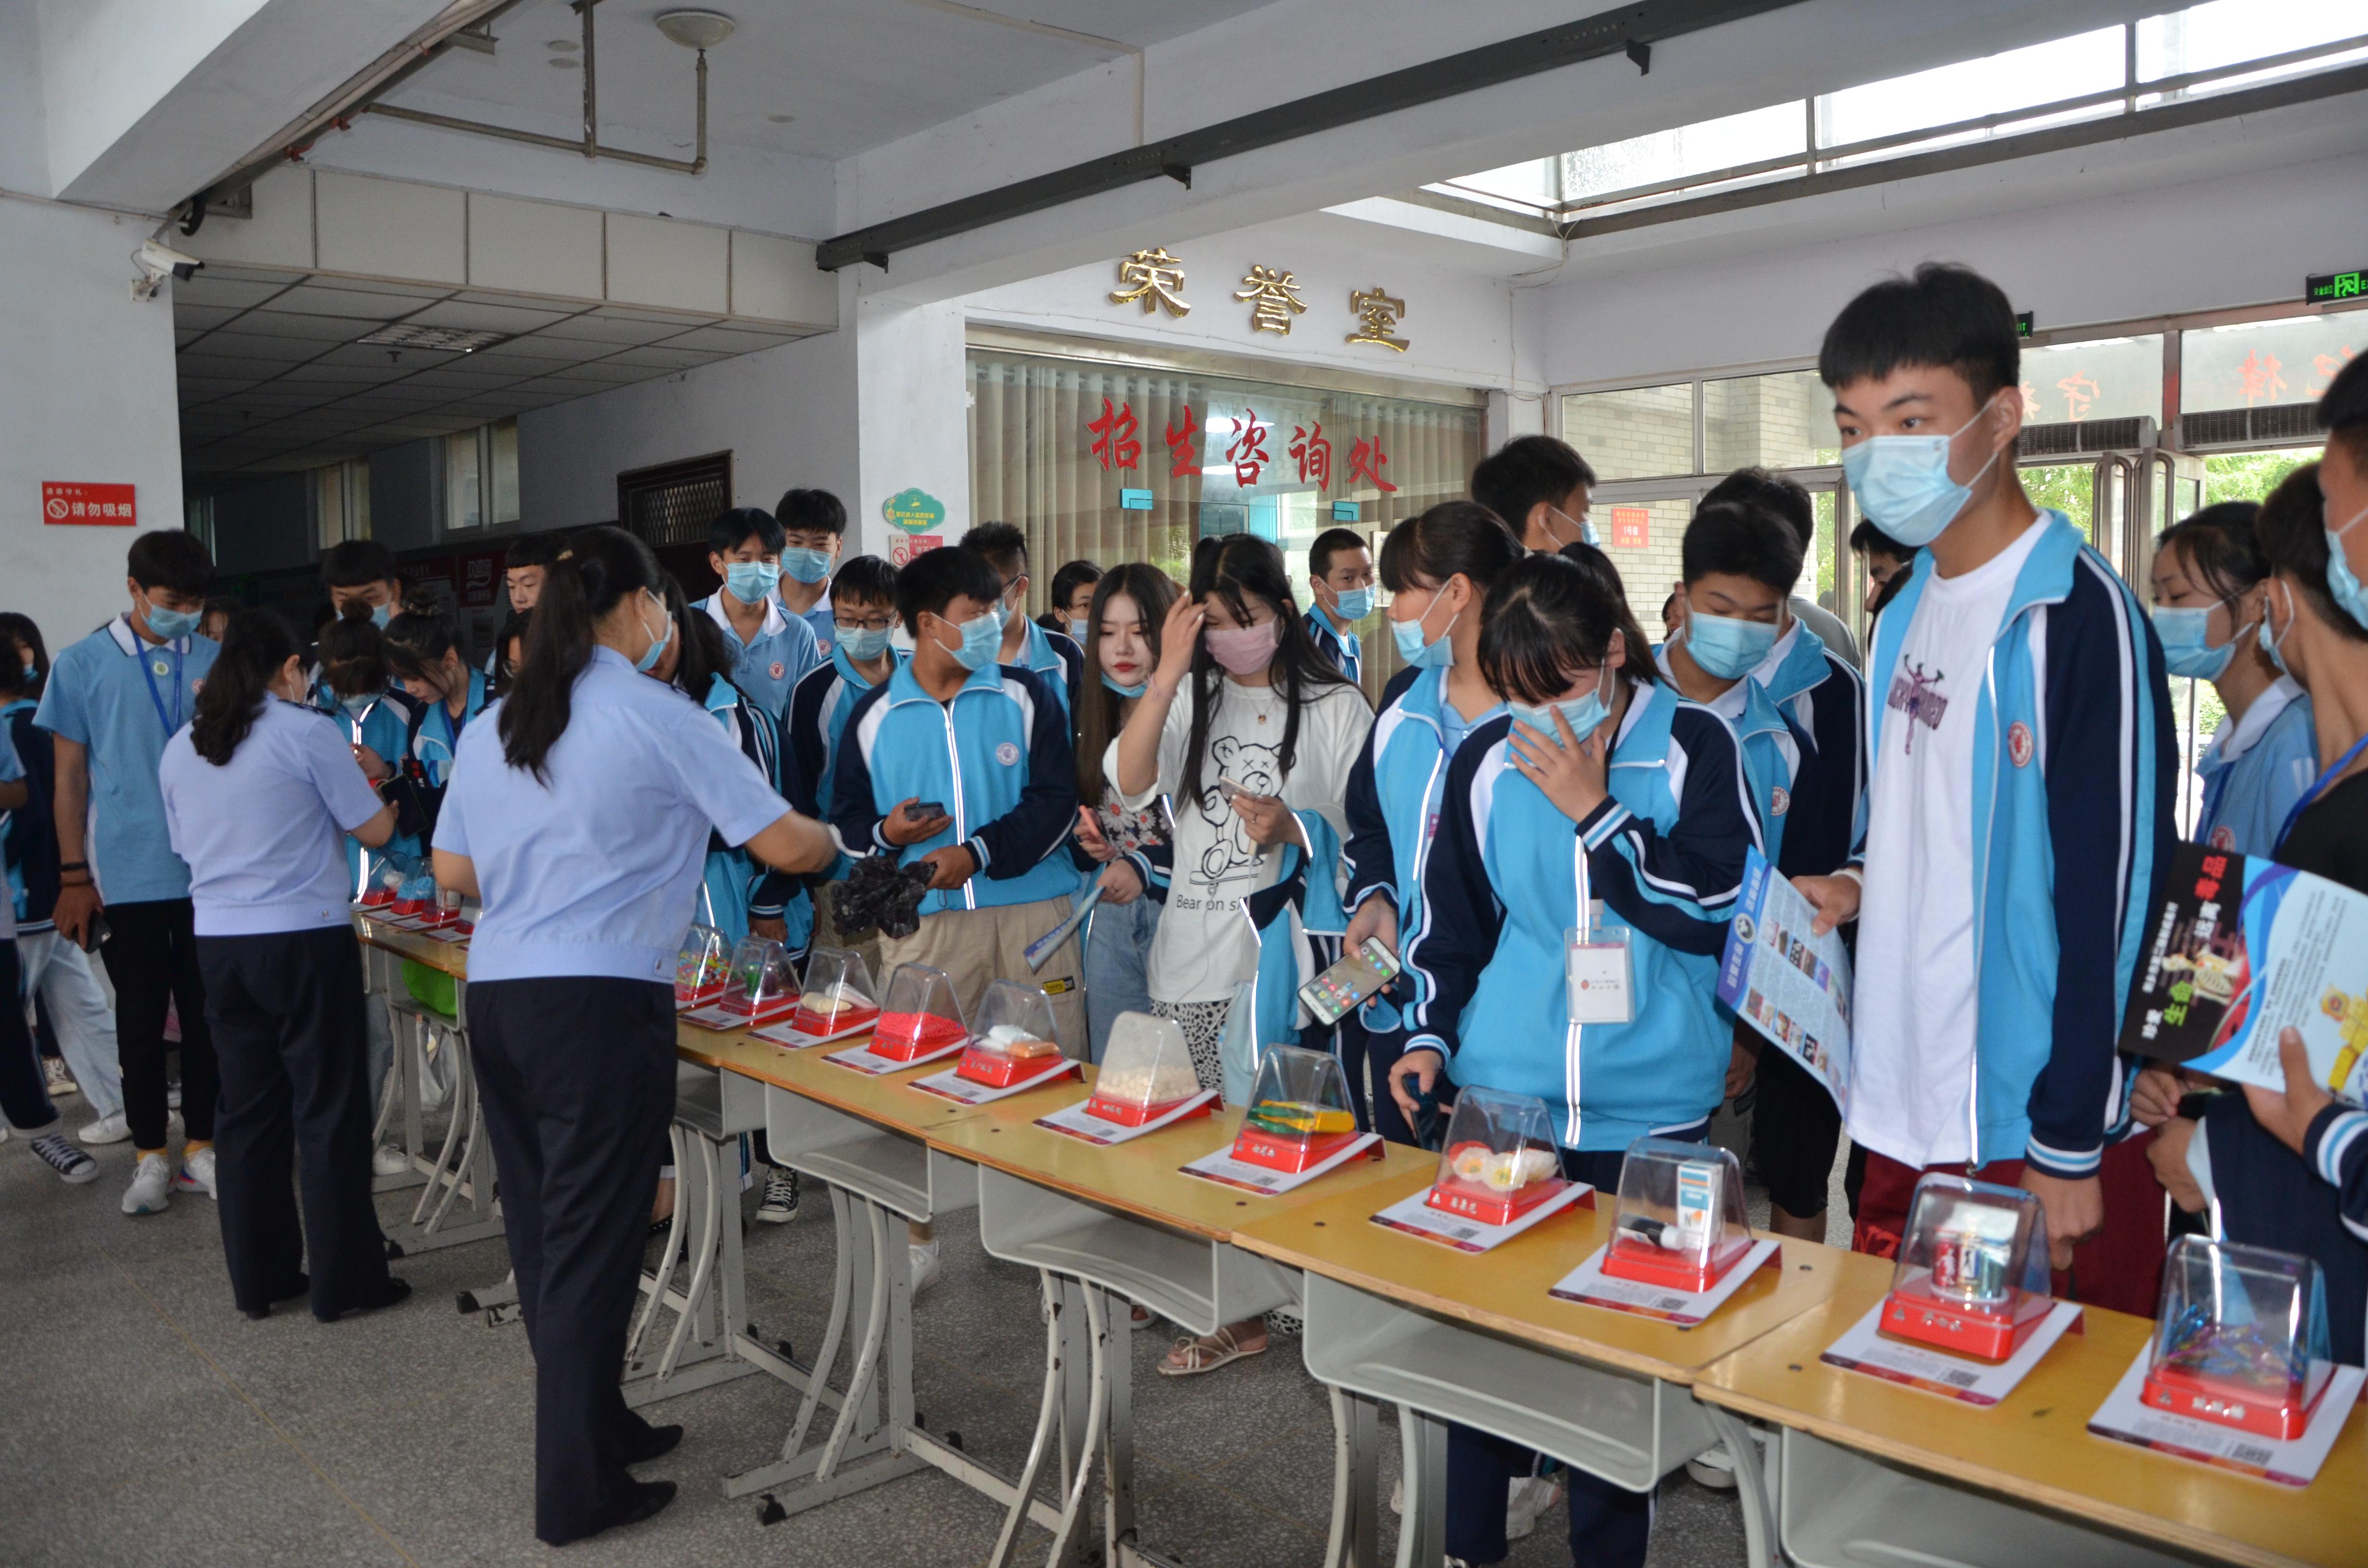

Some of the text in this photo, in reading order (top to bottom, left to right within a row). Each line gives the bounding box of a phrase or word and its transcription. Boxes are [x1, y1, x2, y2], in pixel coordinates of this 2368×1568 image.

[1110, 247, 1410, 352] 荣誉室
[1086, 397, 1398, 492] 招生咨询处
[72, 502, 132, 517] 请勿吸烟
[1623, 526, 1638, 536] 1号楼
[1177, 894, 1202, 910] Bear
[1206, 899, 1224, 910] on
[2195, 856, 2228, 939] 远离 毒品
[2141, 980, 2193, 1041] 珍爱 生命
